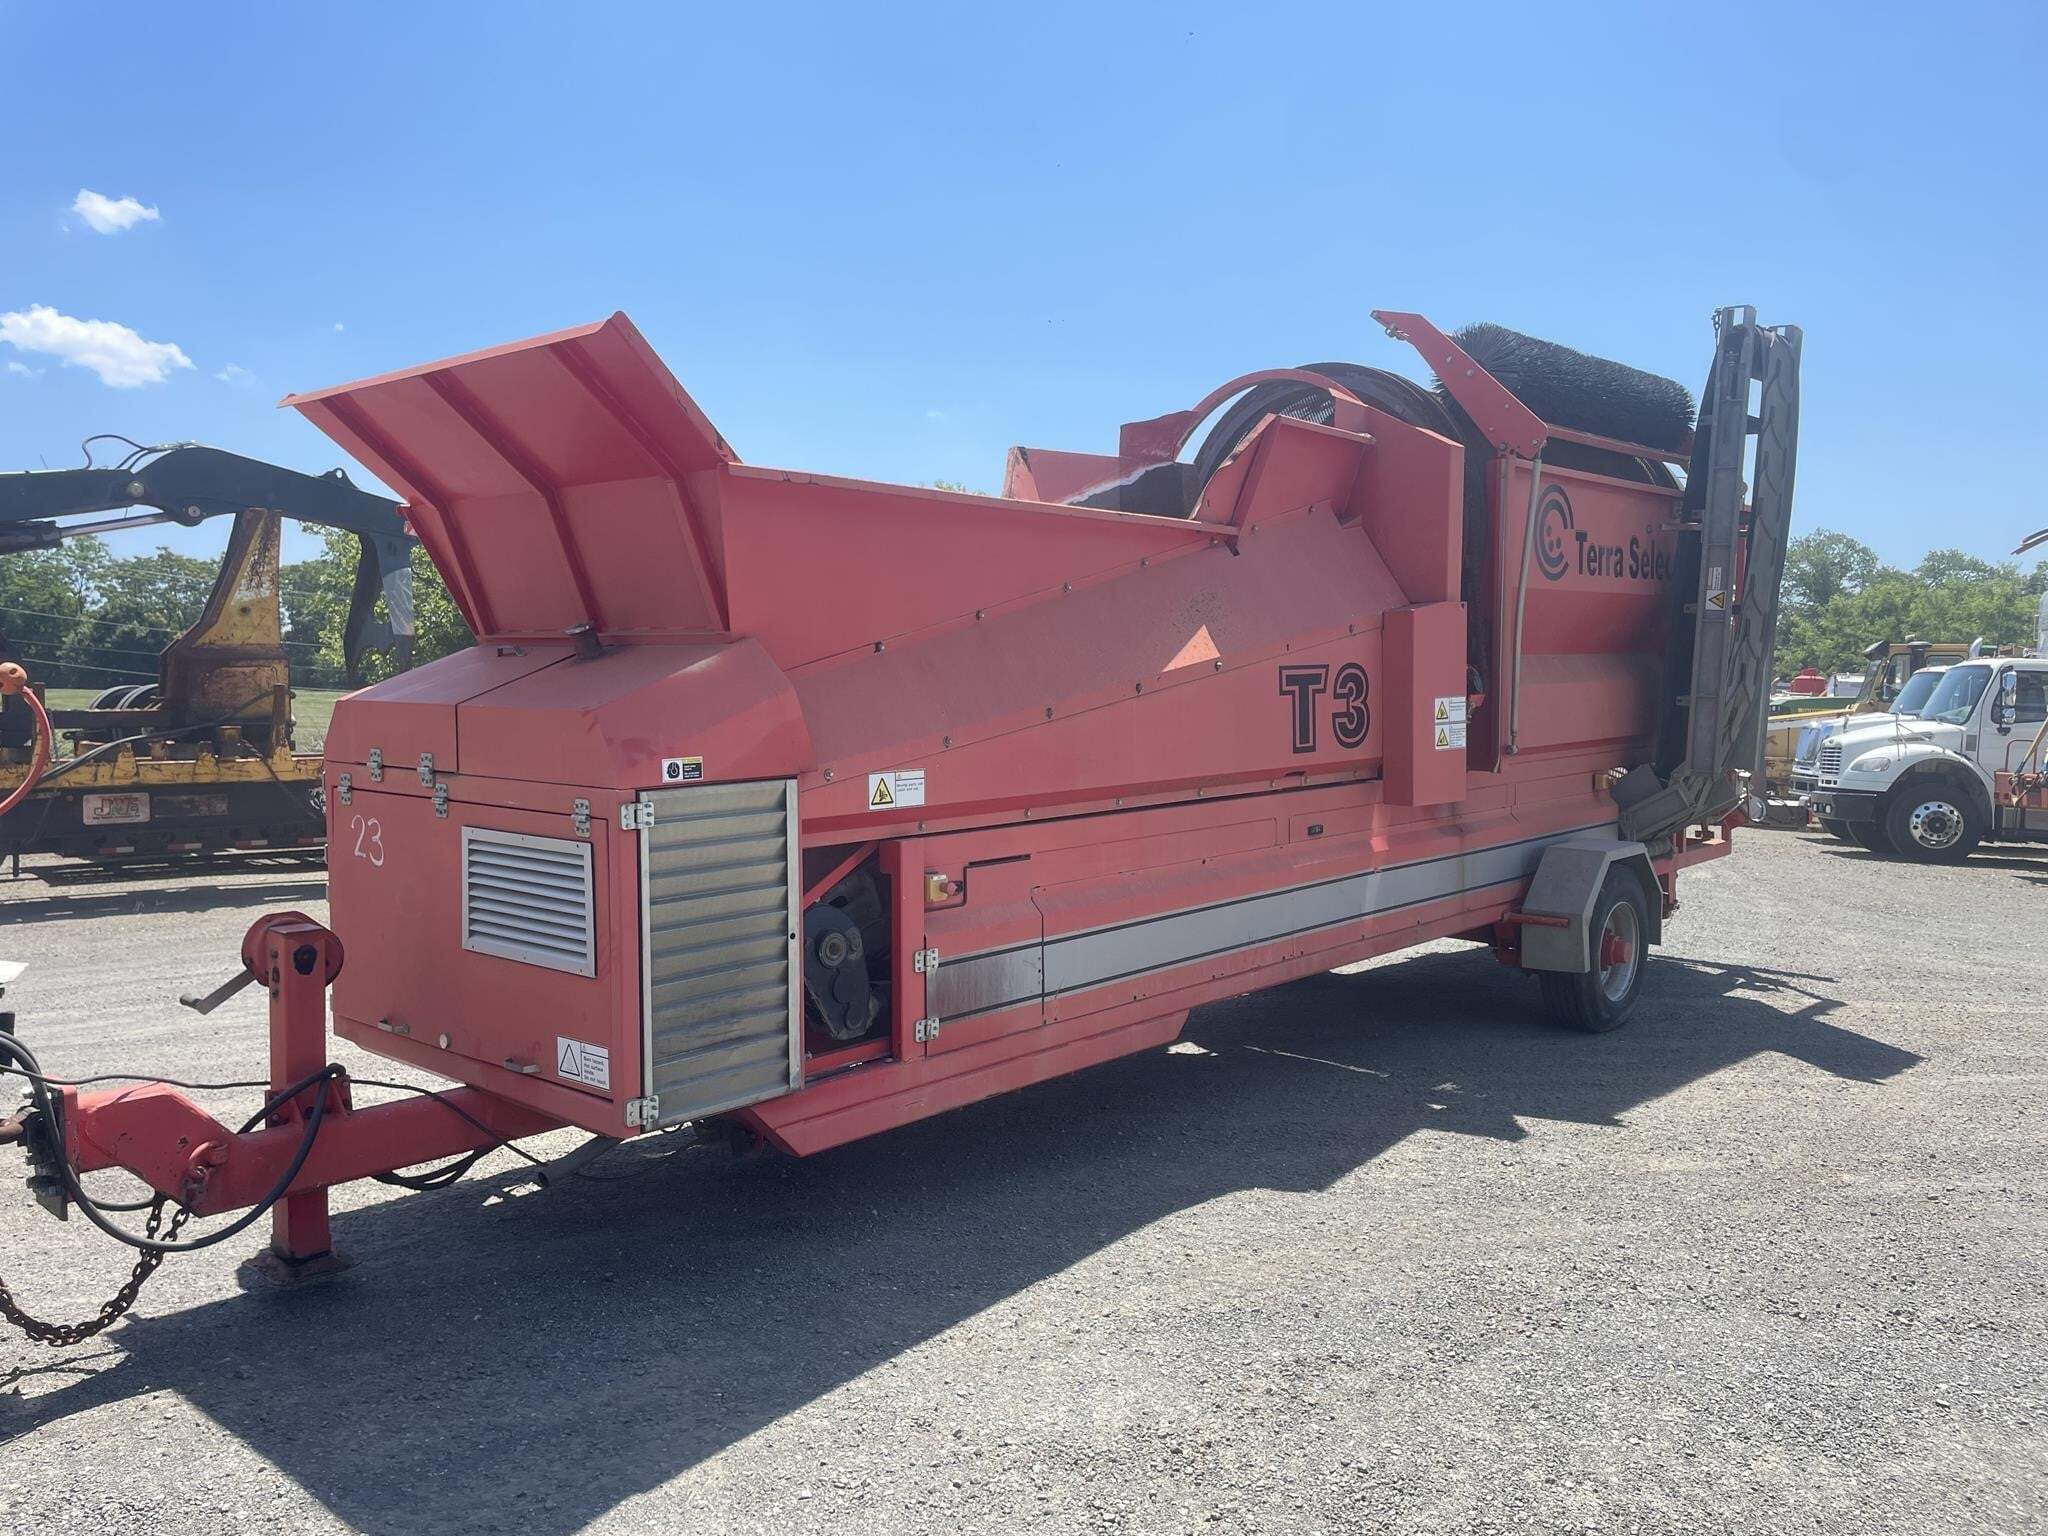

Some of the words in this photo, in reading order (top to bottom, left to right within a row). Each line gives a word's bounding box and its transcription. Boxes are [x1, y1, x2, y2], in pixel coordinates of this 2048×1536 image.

[1575, 530, 1624, 579] Terra
[1629, 535, 1674, 581] Selec
[1279, 662, 1370, 754] T3
[351, 814, 384, 866] 23
